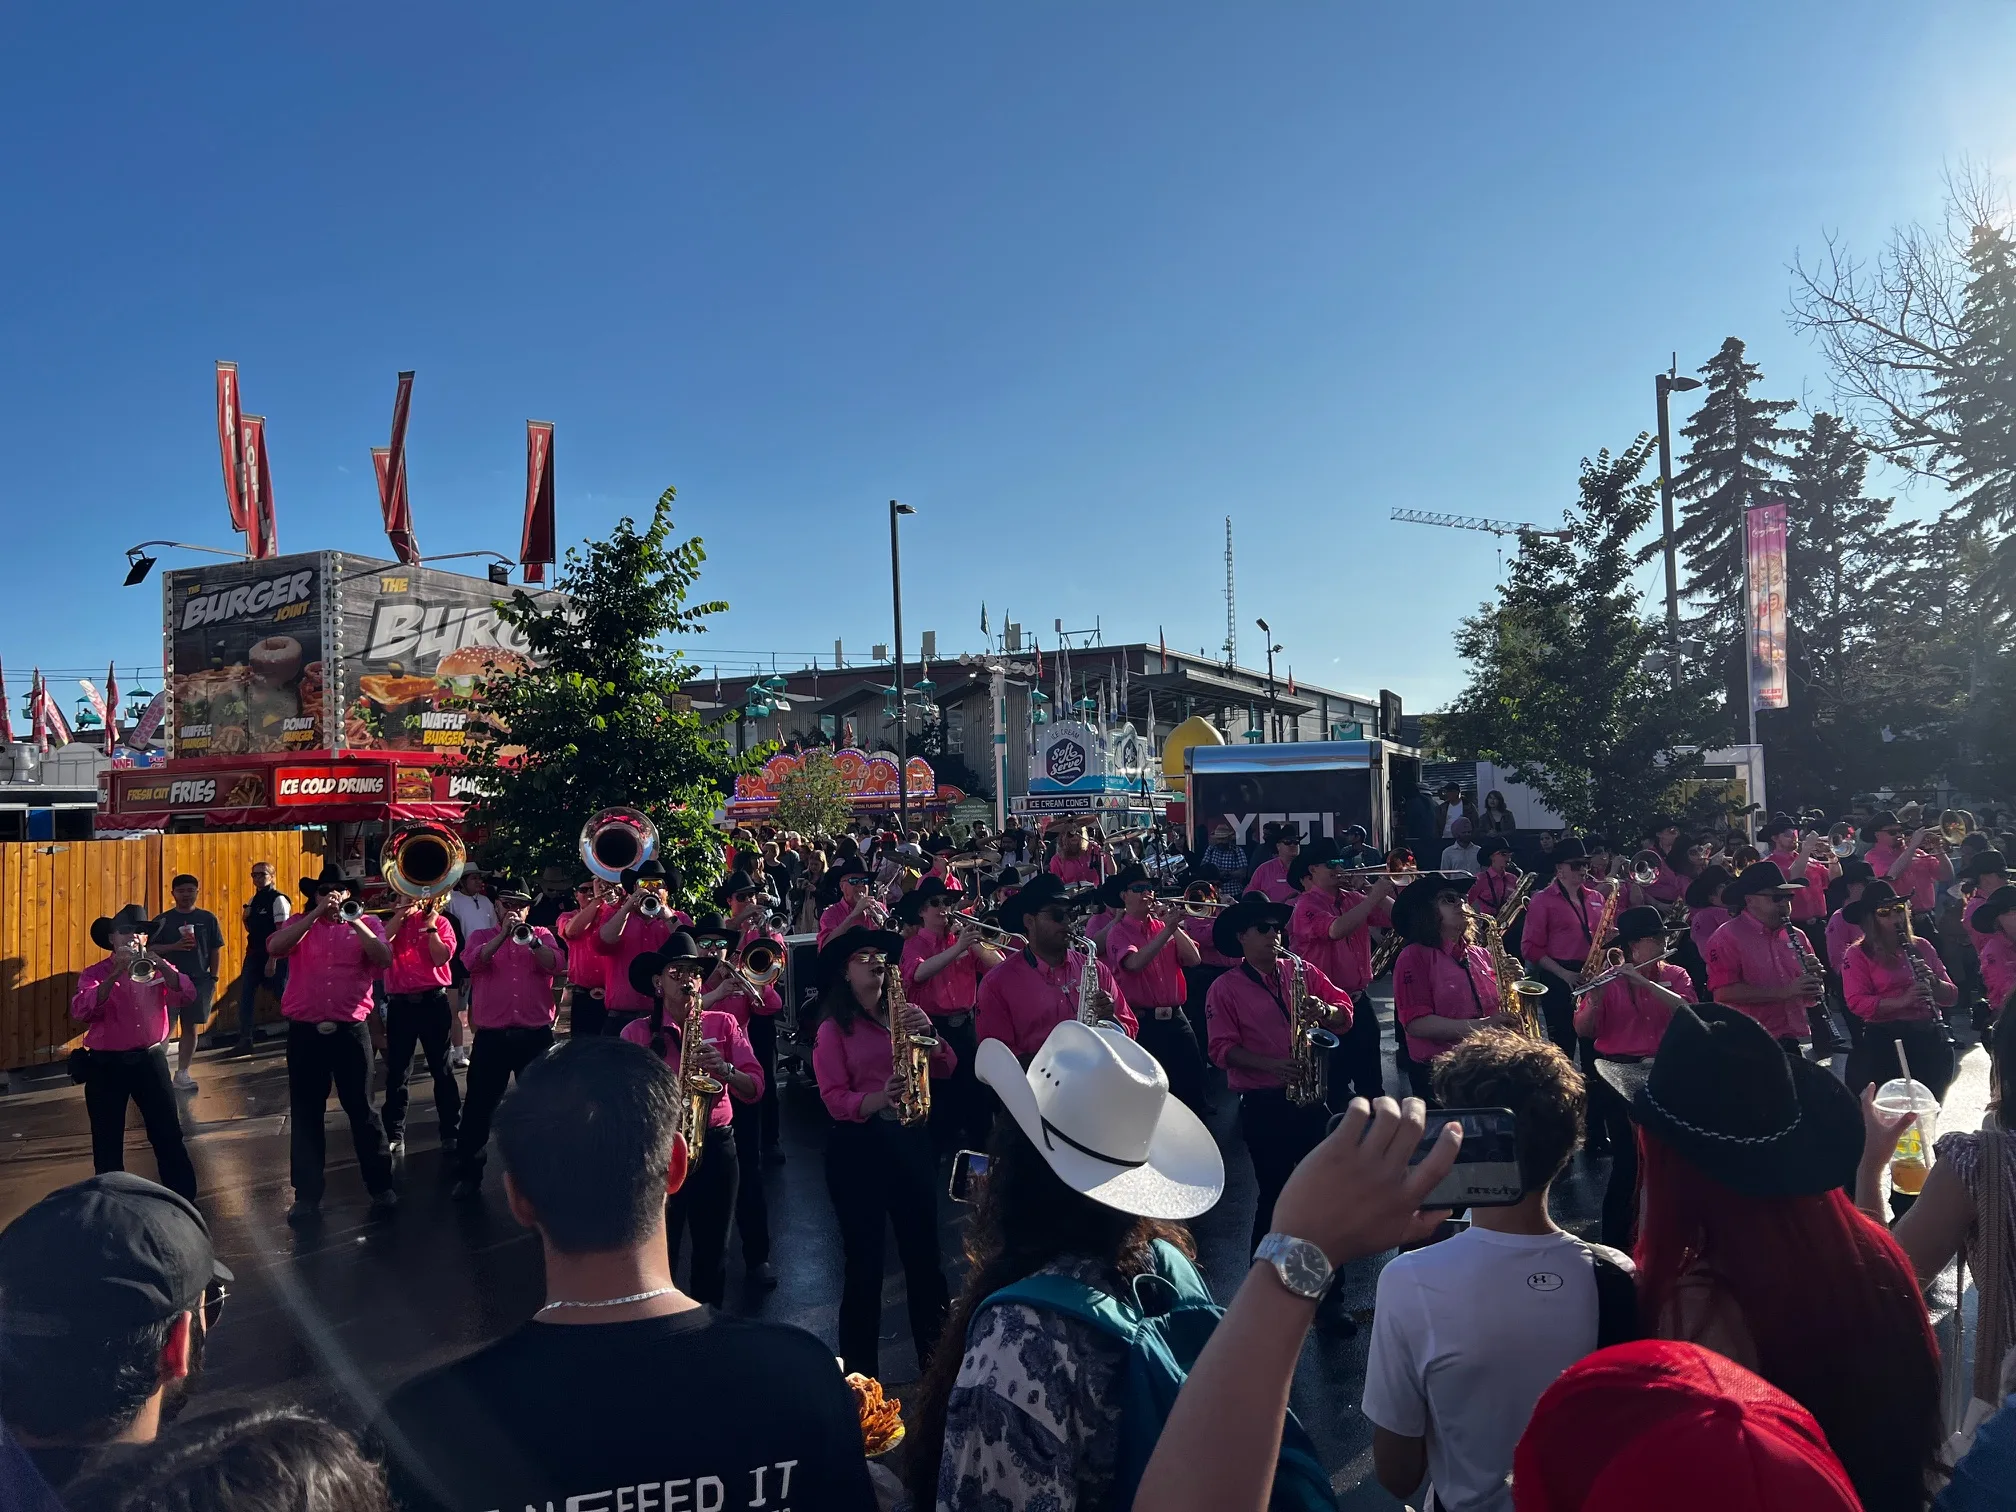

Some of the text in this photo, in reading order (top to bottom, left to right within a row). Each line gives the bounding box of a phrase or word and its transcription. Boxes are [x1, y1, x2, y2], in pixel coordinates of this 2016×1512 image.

[188, 585, 200, 595] THE
[381, 577, 408, 593] THE
[182, 571, 312, 630] BURGER
[274, 601, 310, 622] JOINT
[369, 605, 588, 660] BURG
[181, 724, 212, 738] WAFFLE
[283, 717, 314, 730] DONUT
[283, 730, 314, 742] BURGER
[423, 730, 465, 746] BURGER
[1051, 729, 1080, 740] ICE CREAM
[1051, 742, 1078, 764] Soft
[1050, 754, 1083, 776] Serve
[127, 779, 215, 803] FRESH CUT FRIES
[280, 777, 384, 795] ICE COLD DRINKS
[1029, 798, 1089, 808] ICE CREAM CONES
[748, 1459, 798, 1507] IT
